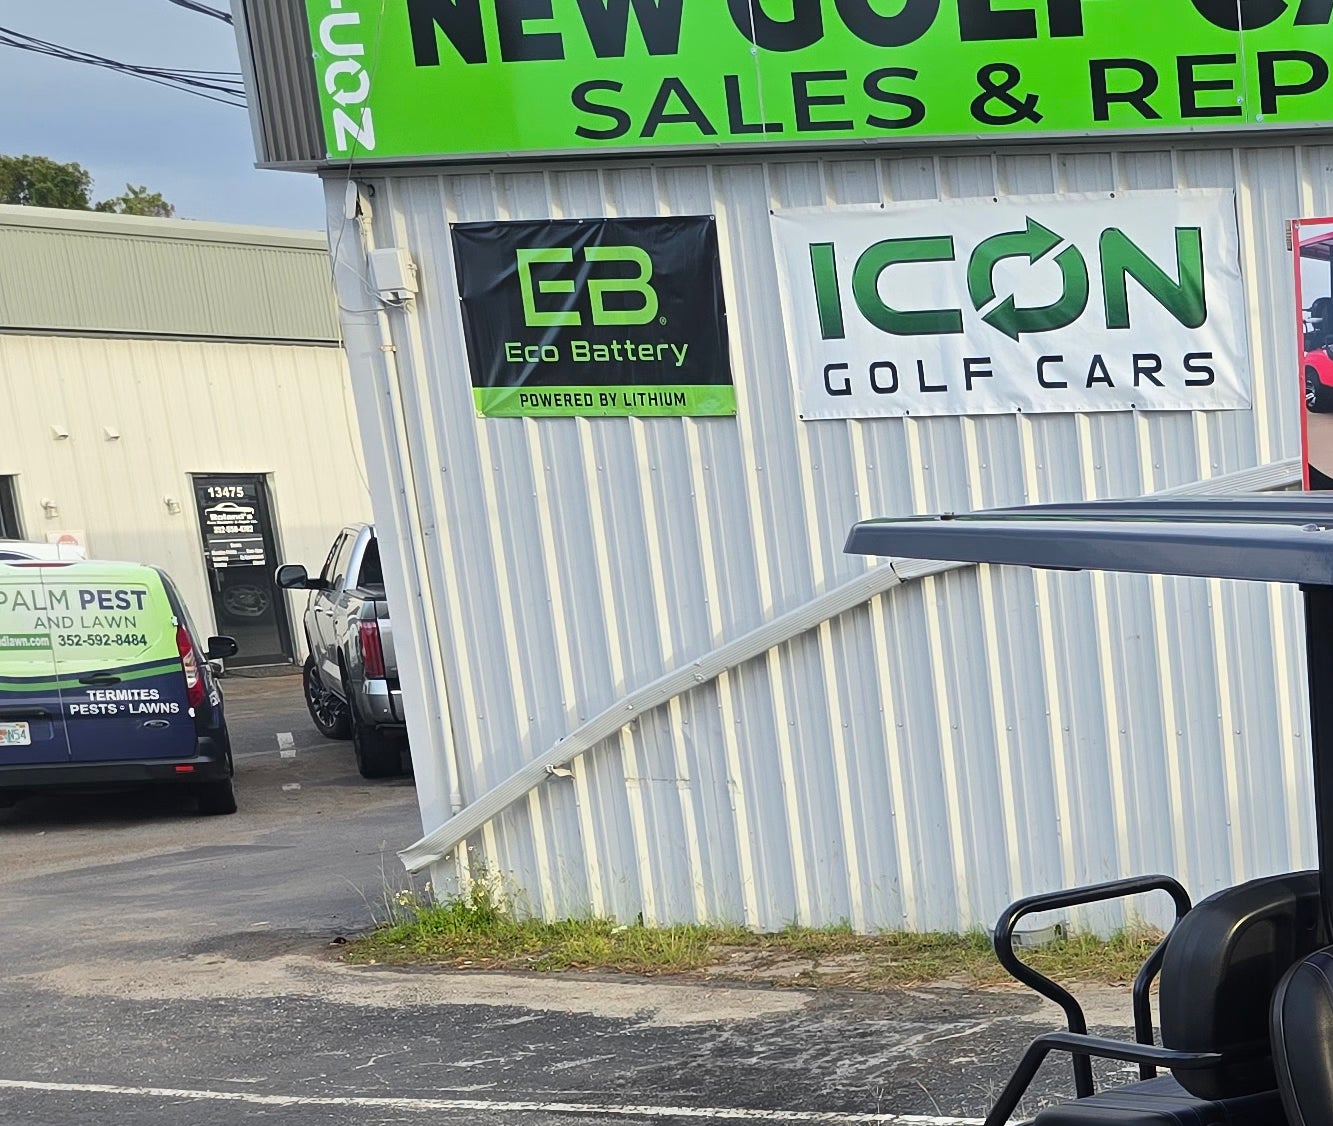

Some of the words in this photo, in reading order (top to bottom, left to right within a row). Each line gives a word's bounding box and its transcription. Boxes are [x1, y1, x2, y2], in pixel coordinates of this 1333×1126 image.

[319, 0, 376, 151] CON
[571, 66, 927, 139] SALES
[968, 62, 1044, 125] &
[808, 215, 1208, 342] ICON
[504, 342, 559, 363] Eco
[571, 339, 689, 366] Battery
[824, 356, 994, 396] GOLF
[1036, 352, 1216, 389] CARS
[520, 393, 594, 407] POWERED
[600, 392, 617, 407] BY
[623, 392, 686, 407] LITHIUM
[207, 486, 245, 498] 13475
[79, 588, 147, 611] PEST
[34, 615, 73, 630] AND
[81, 615, 137, 629] LAWN
[0, 635, 50, 647] dlawn.com
[58, 634, 148, 647] 352-592-8484
[86, 688, 160, 701] TERMITES
[69, 704, 118, 715] PESTS
[128, 702, 180, 715] LAWNS
